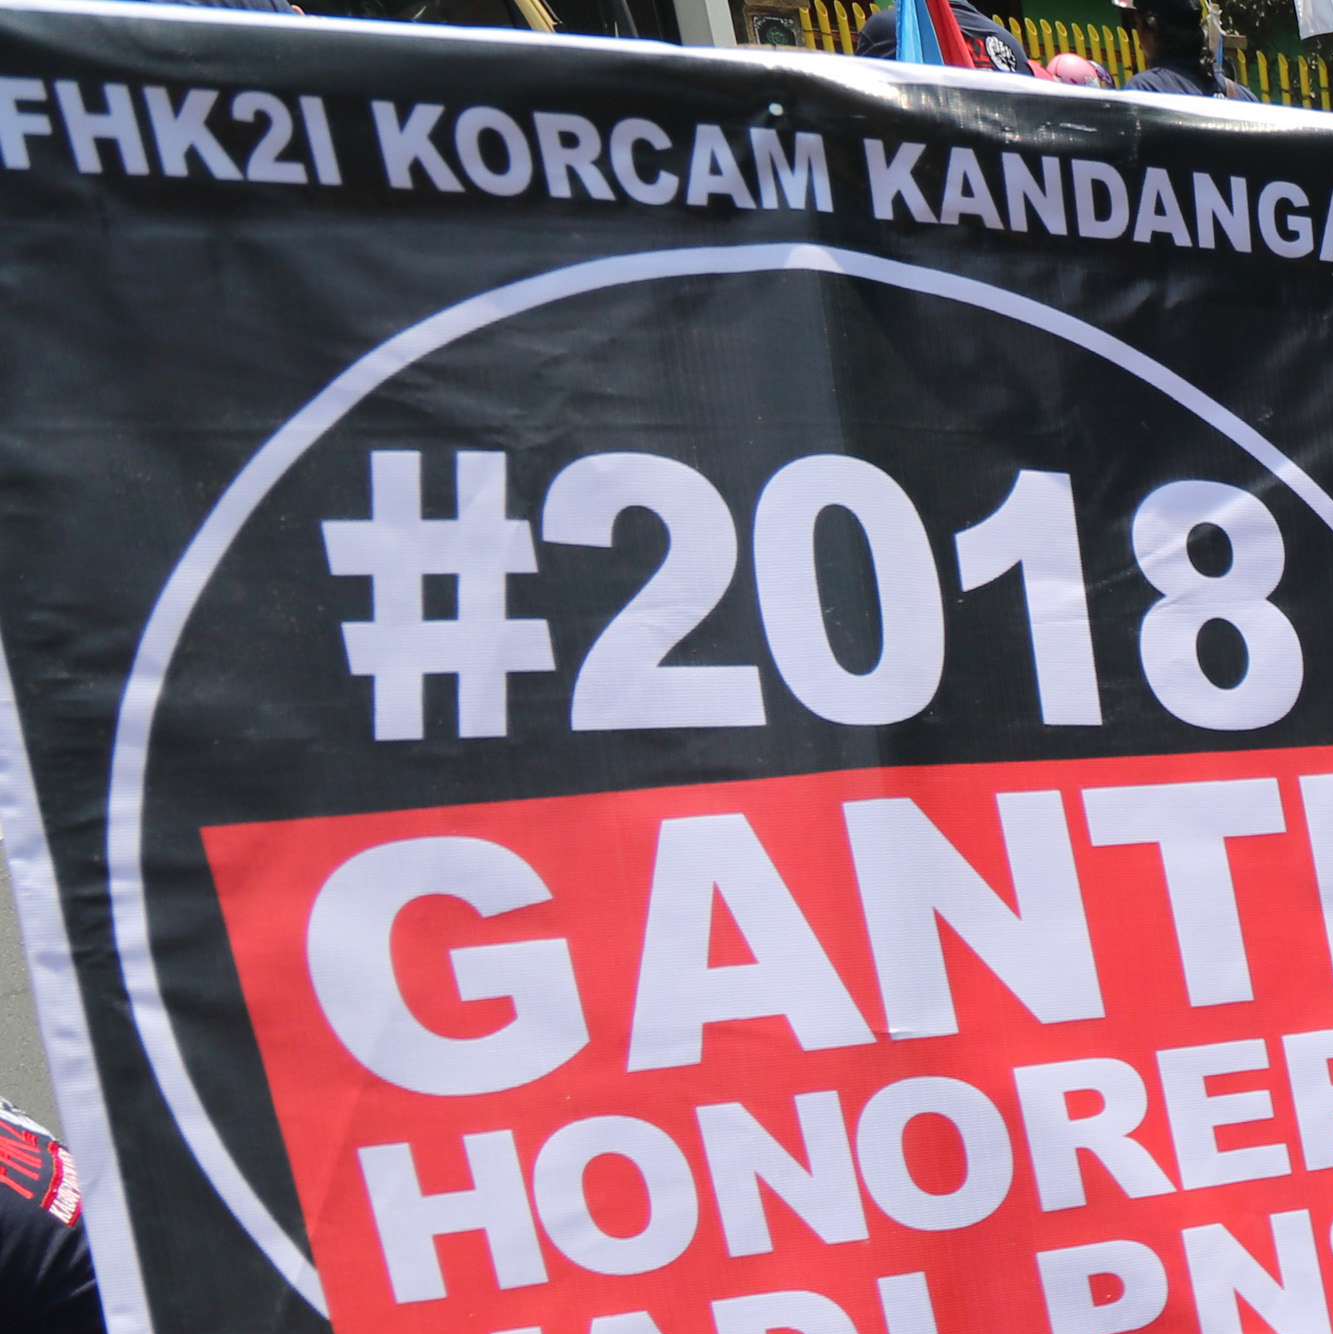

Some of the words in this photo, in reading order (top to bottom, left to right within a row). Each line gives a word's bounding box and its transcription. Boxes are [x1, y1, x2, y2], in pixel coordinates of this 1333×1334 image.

[0, 78, 342, 186] FHK2I
[371, 100, 834, 213] KORCAM
[323, 448, 1308, 742] #2018
